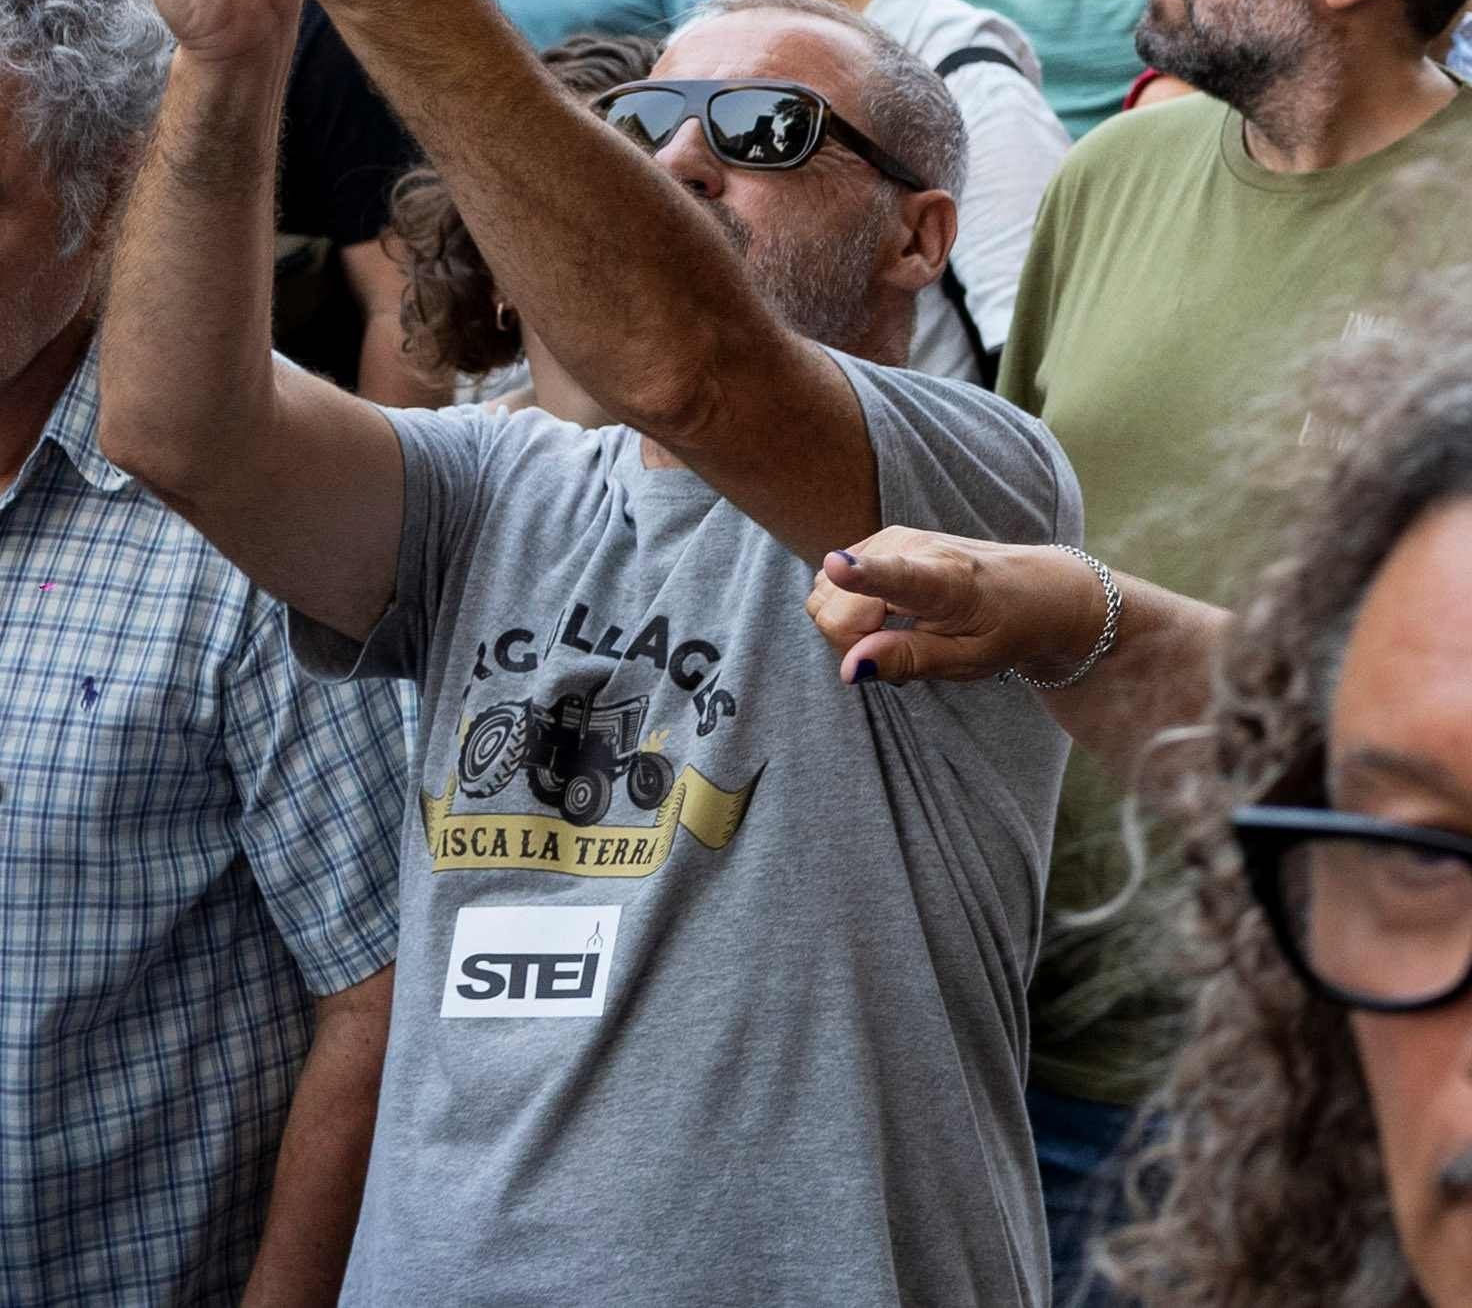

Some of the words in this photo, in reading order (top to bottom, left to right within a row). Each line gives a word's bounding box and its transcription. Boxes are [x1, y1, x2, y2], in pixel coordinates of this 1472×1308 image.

[434, 827, 509, 859] ISCA
[520, 830, 560, 861] LA
[455, 951, 601, 1001] STEI
